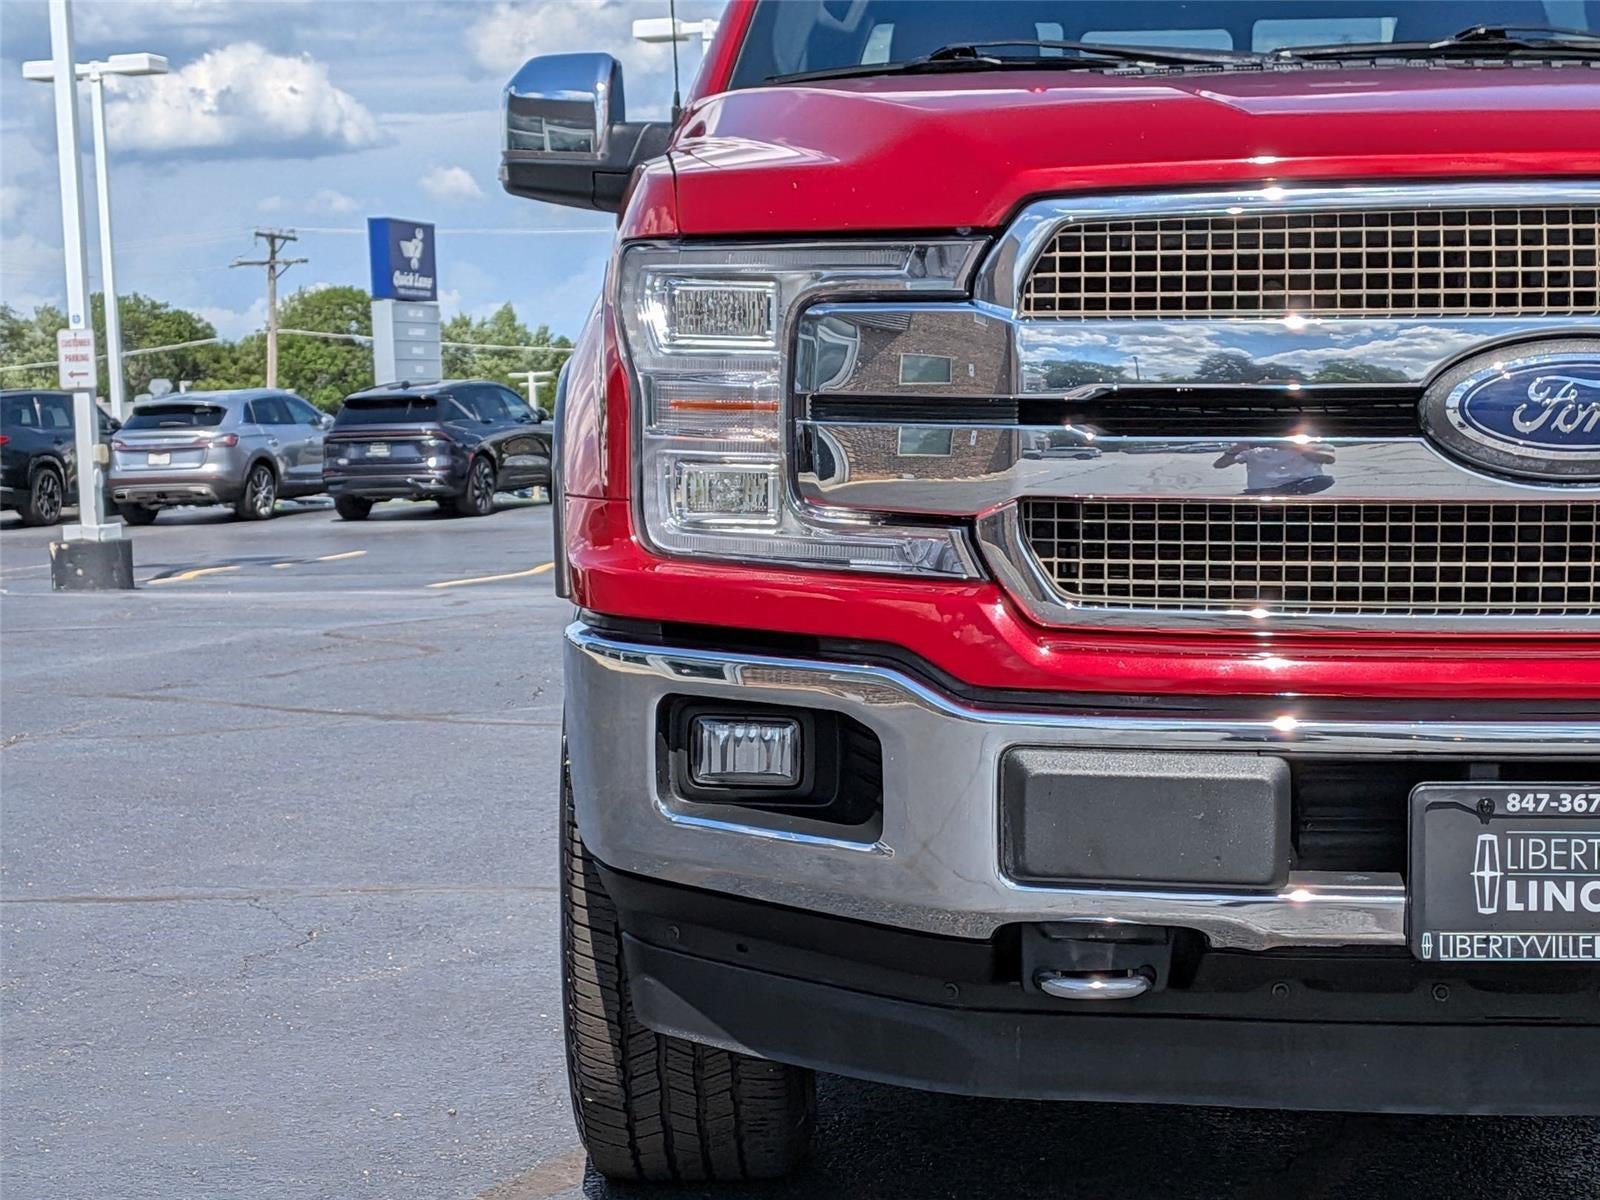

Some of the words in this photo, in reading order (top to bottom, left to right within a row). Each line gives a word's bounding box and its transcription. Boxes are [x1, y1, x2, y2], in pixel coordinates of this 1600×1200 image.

[64, 353, 89, 361] PARKING
[1506, 793, 1600, 813] 847-367
[1507, 838, 1600, 870] LIBERT
[1506, 880, 1600, 912] LINC
[1440, 935, 1592, 958] LIBERTYVILLE
